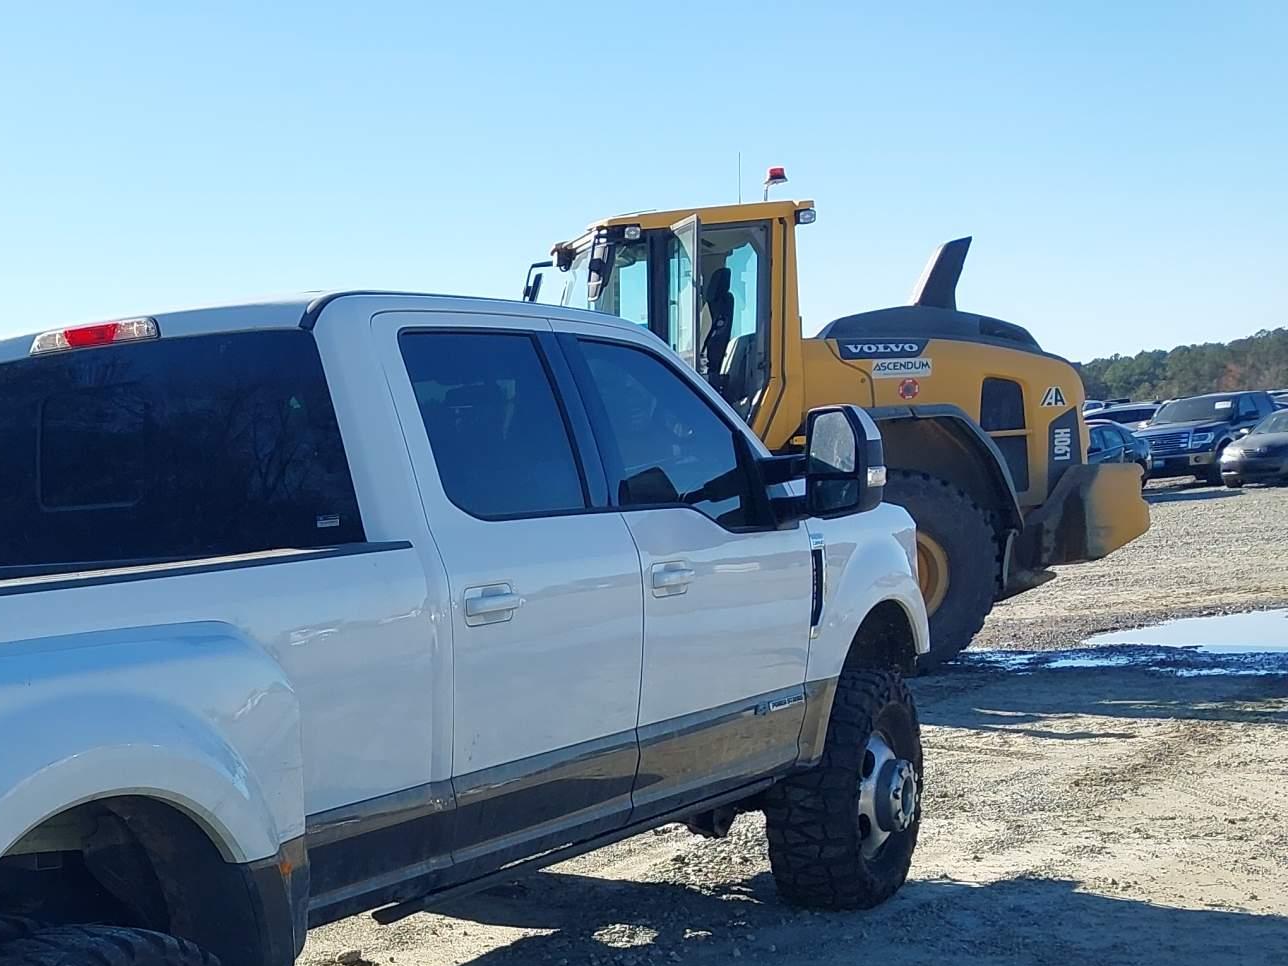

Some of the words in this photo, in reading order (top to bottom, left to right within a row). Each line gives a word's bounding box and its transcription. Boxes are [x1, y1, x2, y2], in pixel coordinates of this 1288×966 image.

[844, 343, 919, 354] VOLVO
[873, 361, 931, 372] ASCENDUM
[1053, 428, 1071, 461] L90H
